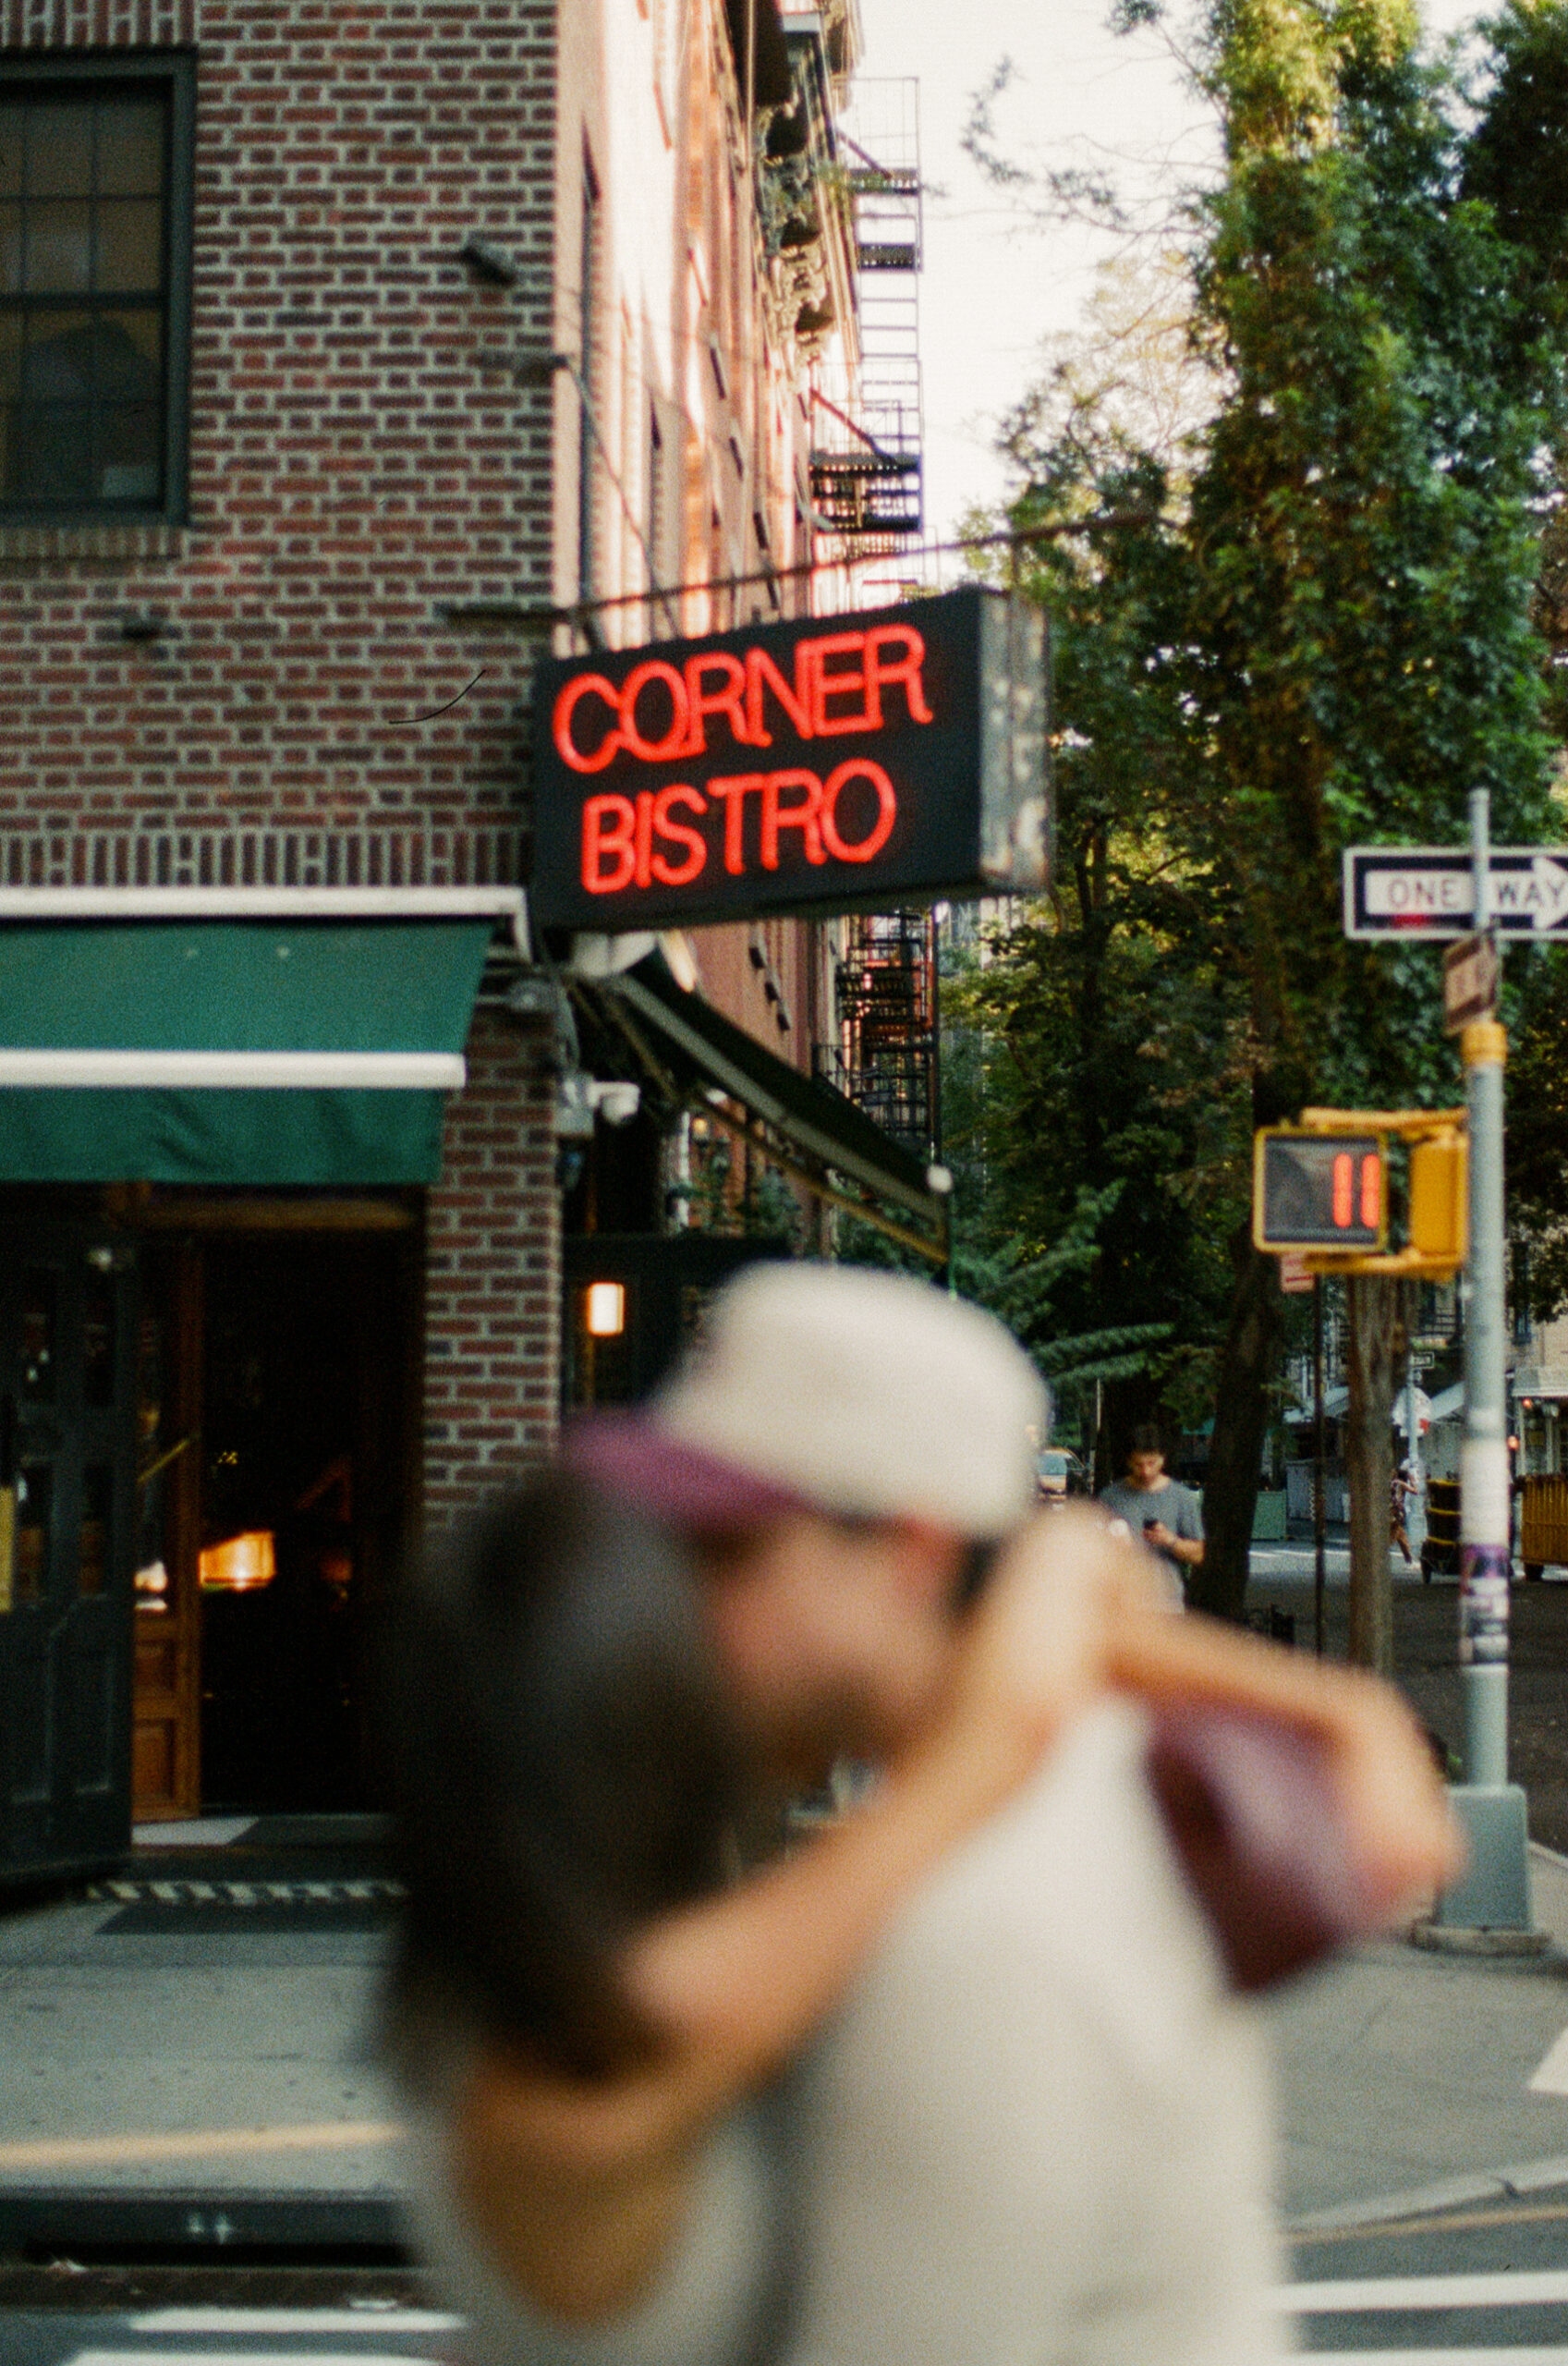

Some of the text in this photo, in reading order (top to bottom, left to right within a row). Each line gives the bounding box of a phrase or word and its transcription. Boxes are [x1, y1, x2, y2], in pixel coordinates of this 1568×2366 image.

[553, 623, 933, 774] CORNER
[580, 758, 897, 895] BISTRO
[1388, 878, 1565, 909] ONE WAY
[1333, 1153, 1381, 1228] 11
